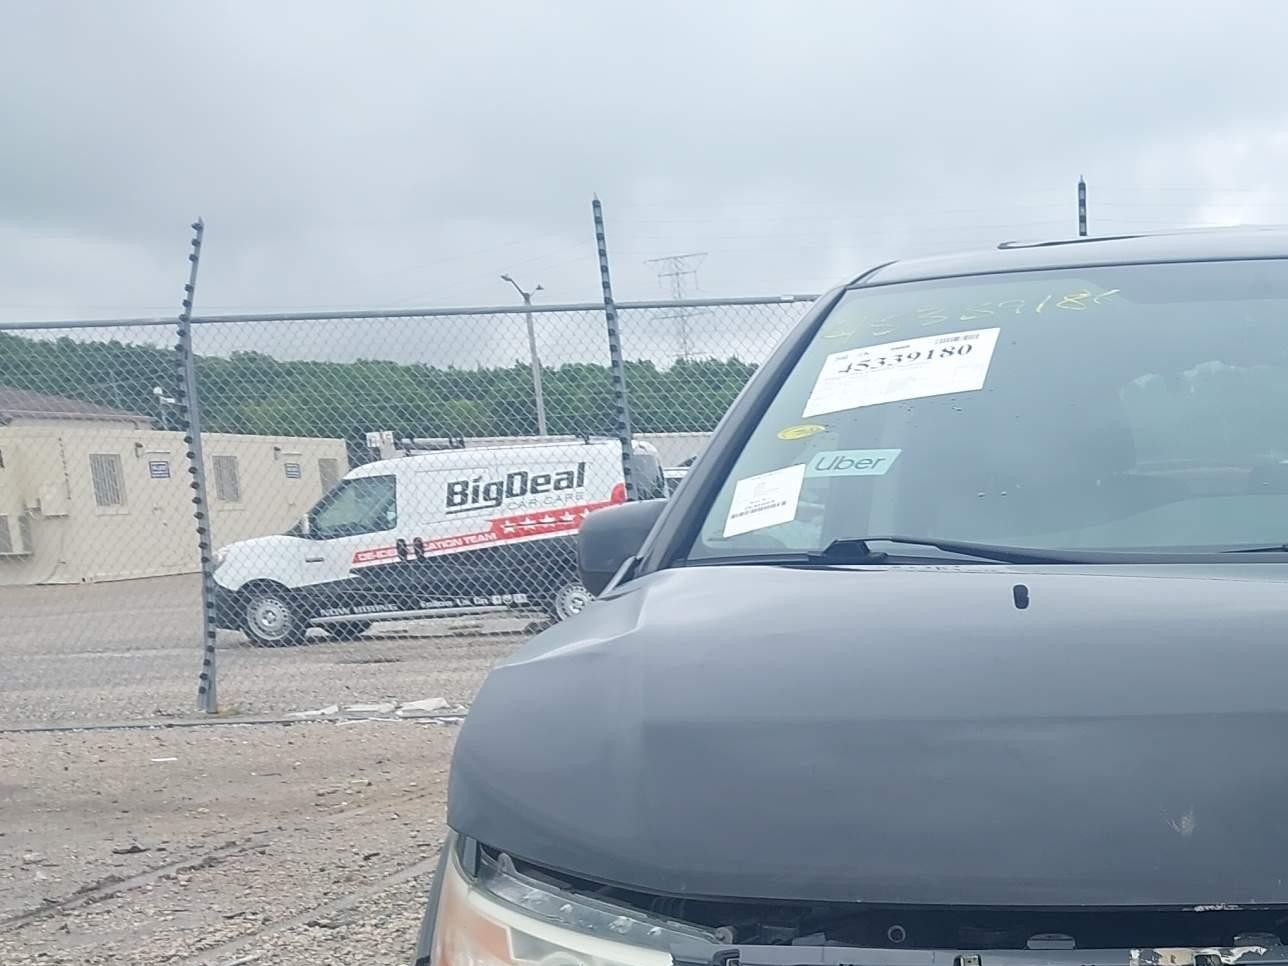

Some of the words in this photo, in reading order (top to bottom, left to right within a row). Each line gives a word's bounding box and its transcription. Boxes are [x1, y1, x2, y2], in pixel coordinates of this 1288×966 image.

[837, 343, 973, 374] 45339180
[814, 455, 886, 472] Uber
[446, 462, 586, 515] BigDeal
[463, 531, 497, 544] TEAM
